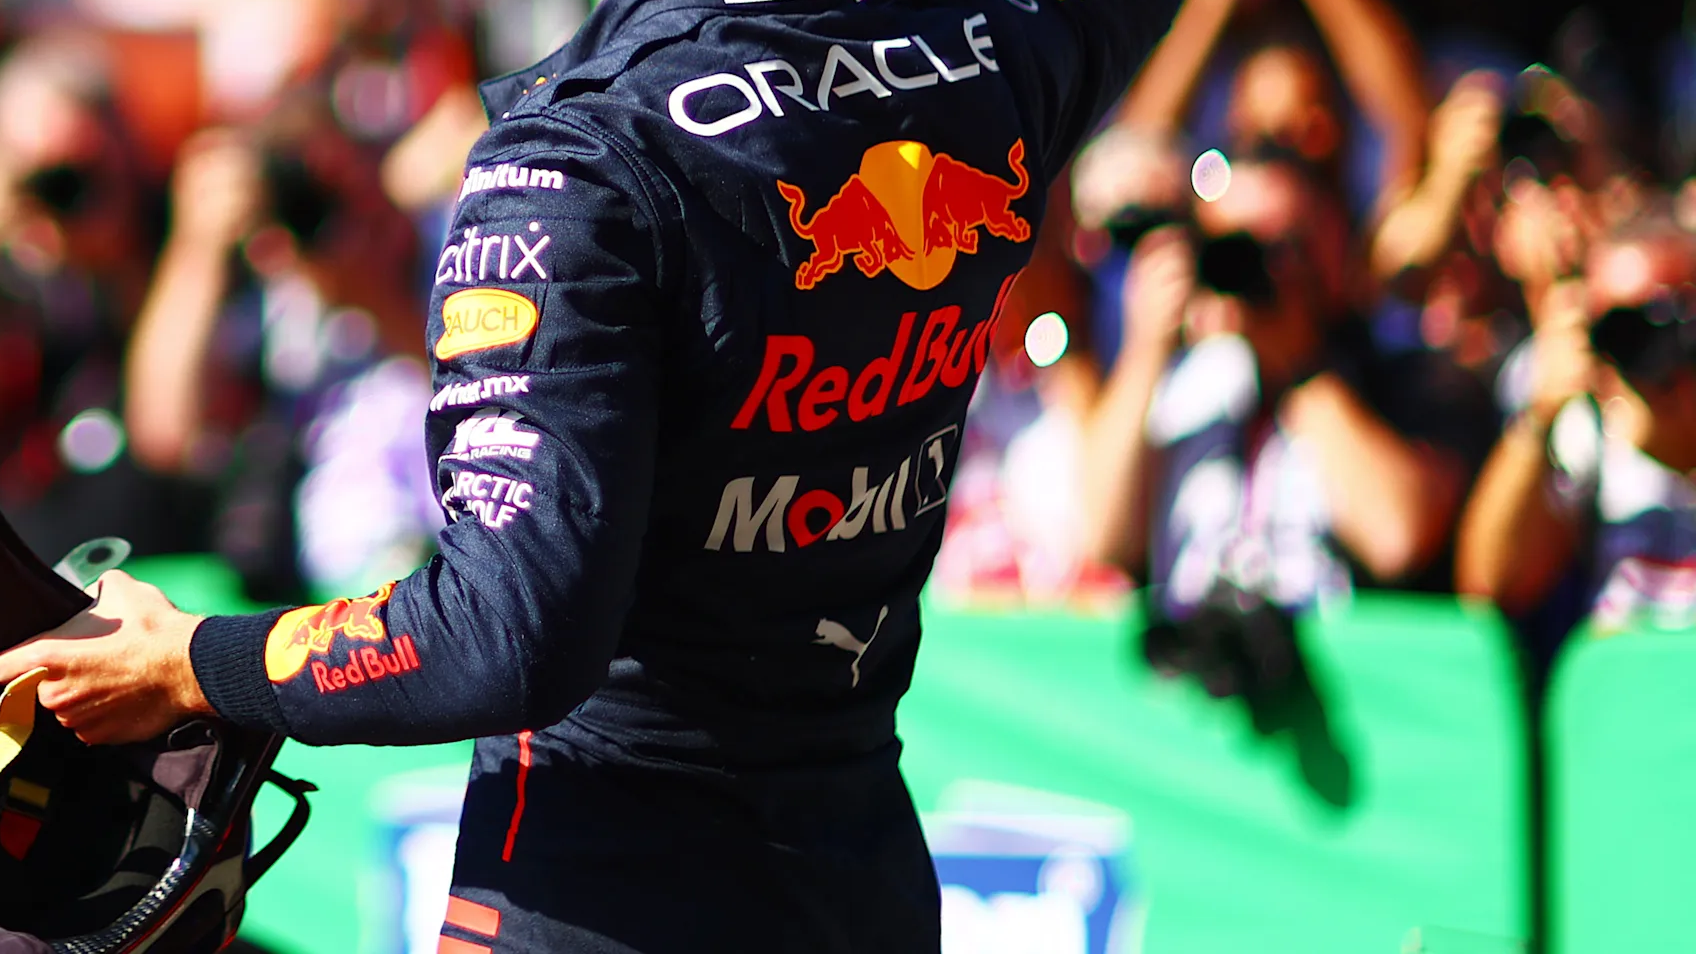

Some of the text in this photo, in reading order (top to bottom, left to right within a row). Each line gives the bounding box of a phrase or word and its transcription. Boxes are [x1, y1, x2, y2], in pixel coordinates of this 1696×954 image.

[667, 12, 1001, 137] ORACLE
[435, 221, 551, 286] citrix
[470, 445, 532, 460] RACING
[467, 499, 518, 529] OLF
[704, 455, 912, 553] Mobil
